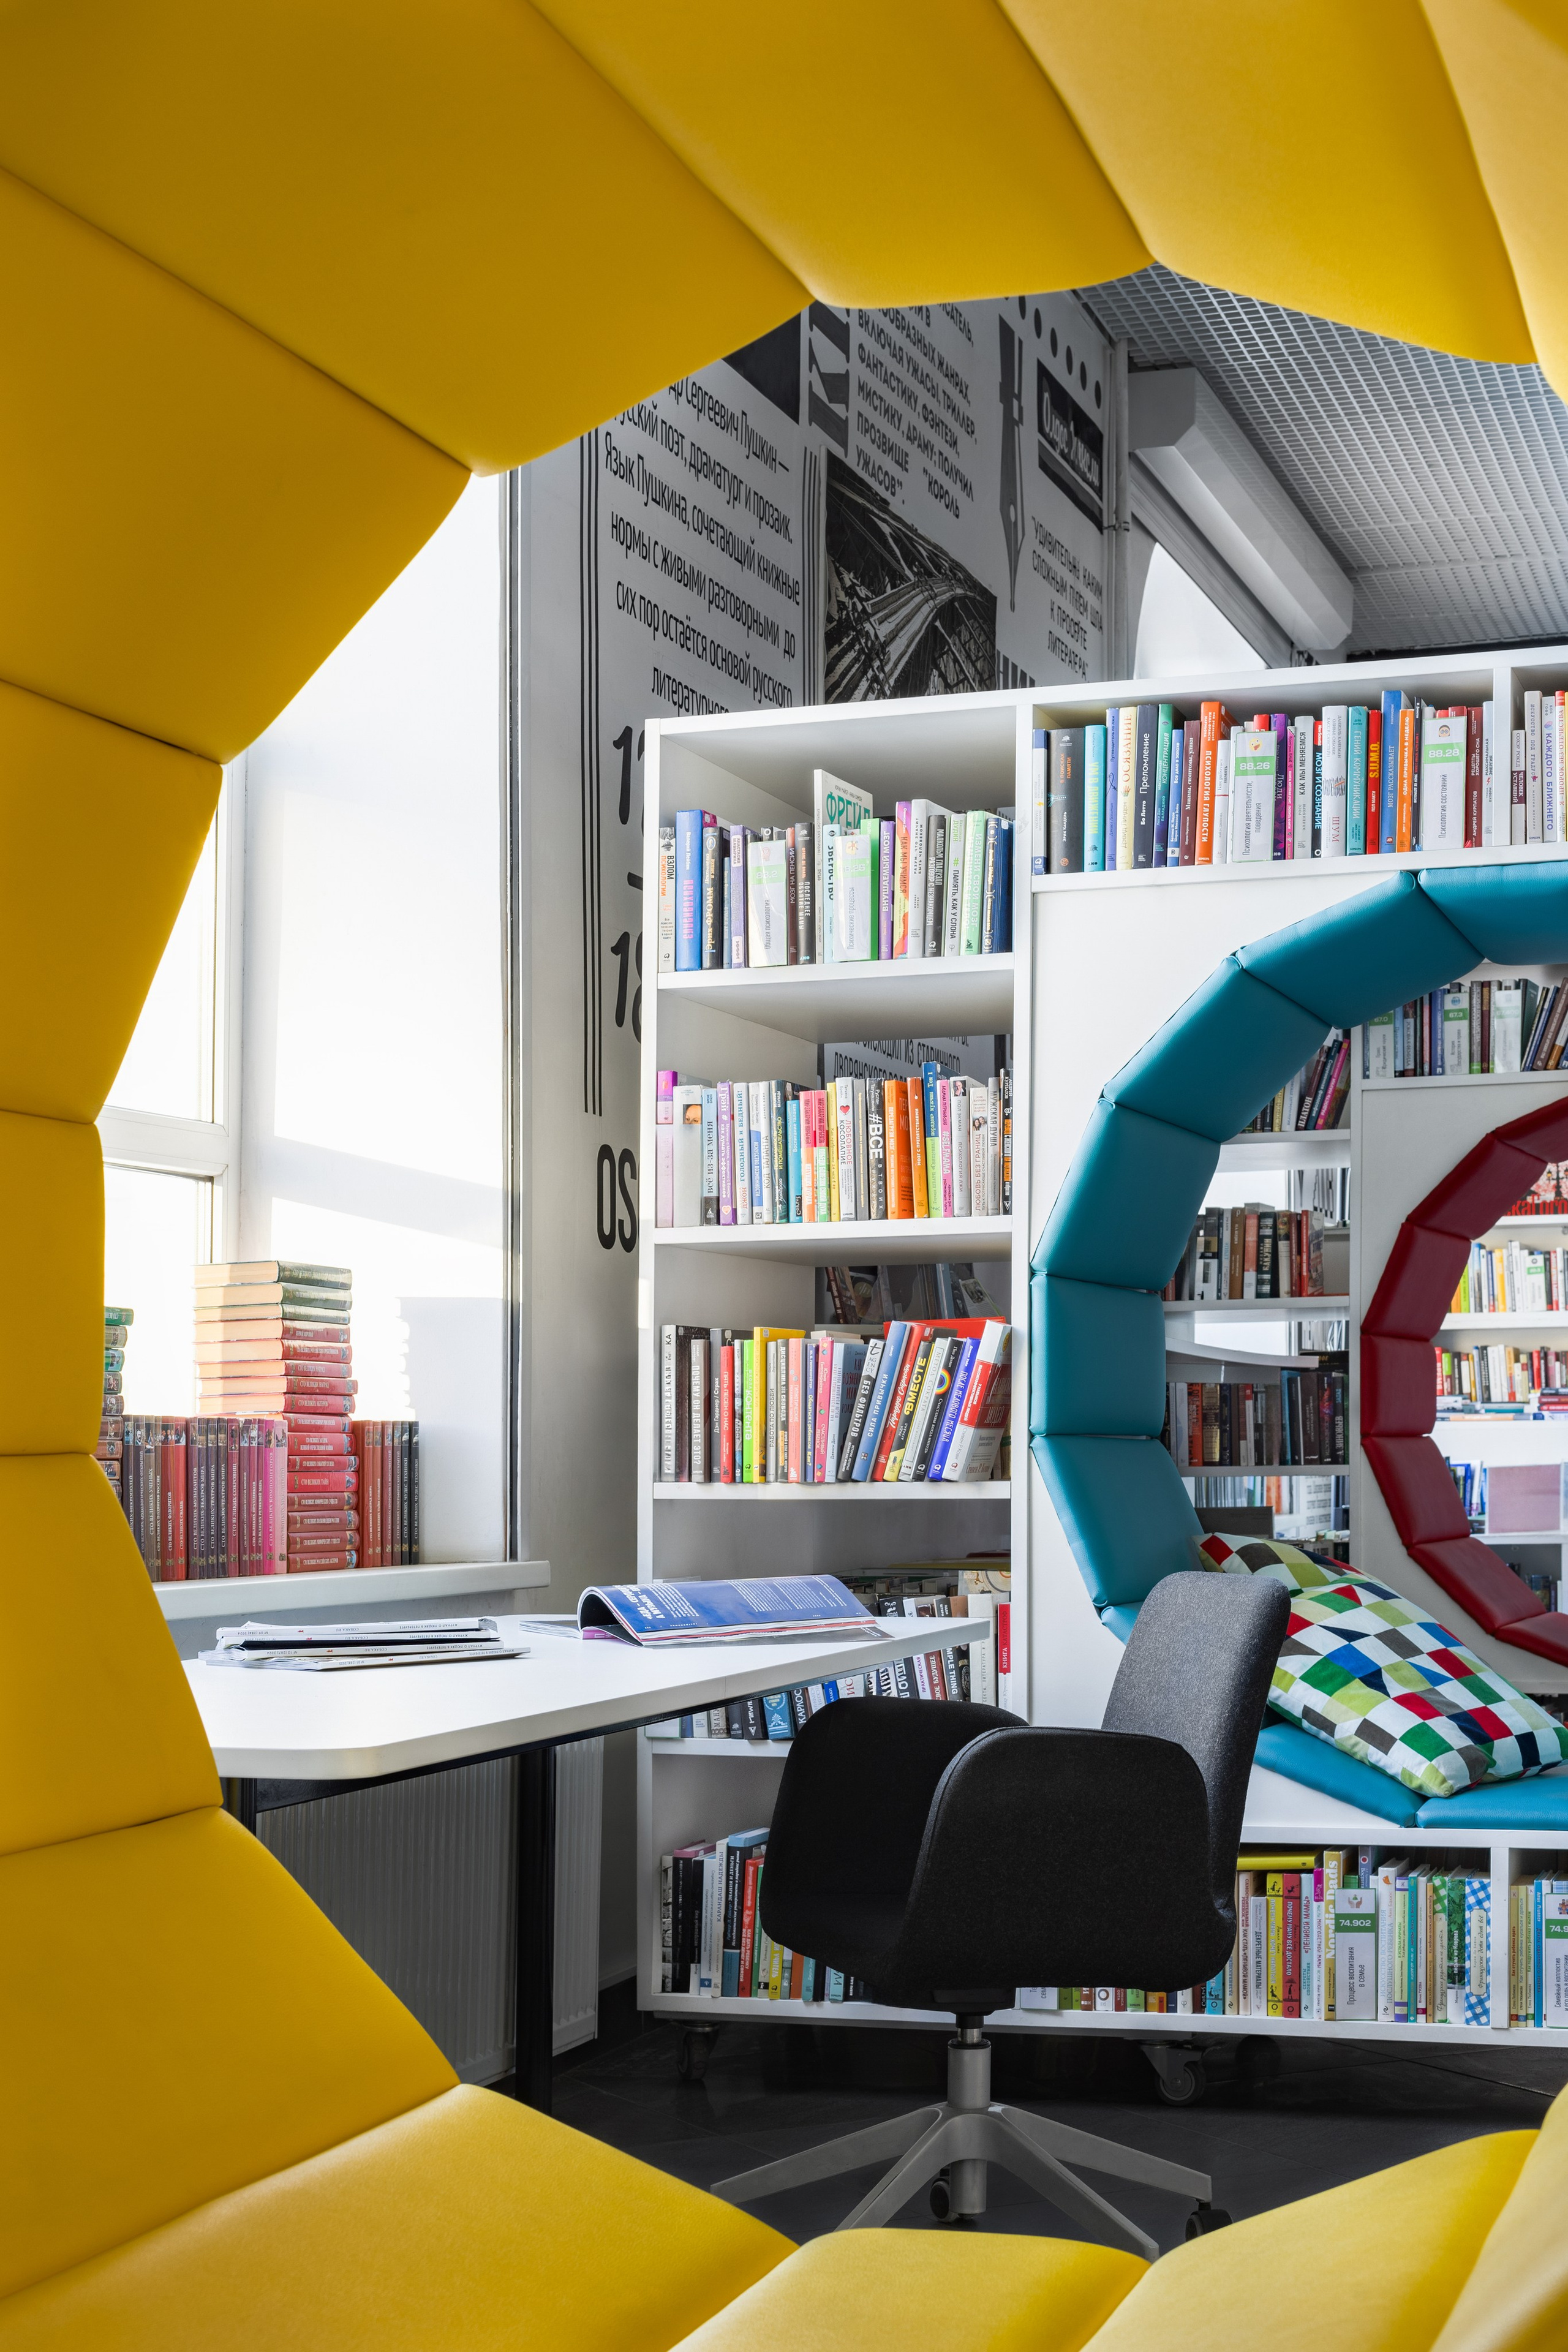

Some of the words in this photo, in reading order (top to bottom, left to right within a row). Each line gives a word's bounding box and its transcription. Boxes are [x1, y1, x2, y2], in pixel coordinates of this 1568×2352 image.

[858, 307, 903, 371] ВКЛЮЧАЯ
[906, 352, 941, 407] УЖАСЫ,
[943, 389, 977, 445] ТРИЛЛЕР,
[937, 351, 971, 408] ЖАНРАХ,
[685, 375, 739, 441] Сергеевич
[741, 409, 777, 473] Пушкин
[858, 410, 910, 473] ПРОЗВИЩЕ
[922, 403, 960, 459] ФЭНТЕЗИ,
[661, 418, 687, 467] поэт,
[689, 441, 744, 510] драматург
[745, 484, 751, 511] и
[753, 489, 793, 545] прозаик.
[907, 421, 937, 469] ДРАМУ;
[938, 449, 974, 502] ПОЛУЧИЛ
[605, 431, 635, 488] Язык
[637, 453, 690, 532] Пушкина,
[692, 503, 756, 574] сочетающий
[756, 555, 800, 606] книжные
[611, 511, 650, 564] нормы
[653, 540, 659, 569] с
[660, 544, 706, 601] живыми
[707, 576, 780, 649] разговорными
[783, 629, 796, 663] до
[616, 581, 637, 619] сих
[639, 594, 660, 641] пор
[662, 614, 707, 662] остаётся
[709, 639, 751, 688] основой
[1121, 714, 1132, 782] ОСЯЗАНИЕ
[1353, 731, 1362, 755] ГЕНИЙ
[1369, 742, 1380, 778] S.U.M.O.
[1428, 748, 1460, 759] 88.28
[1139, 733, 1150, 794] Преломление
[1239, 761, 1270, 771] 88.26
[1299, 769, 1306, 782] МЫ
[1244, 781, 1254, 820] деятельности,
[1352, 758, 1362, 820] КОММУНИКАЦИИ
[1088, 786, 1099, 835] ДВИЖЕНИИ
[1140, 817, 1147, 826] Бо
[936, 829, 944, 859] МАЛКОЛЬМ
[1242, 820, 1251, 856] Психология
[683, 880, 694, 939] ПСИХОАНАЛИЗ
[926, 888, 935, 926] НЕЗНАКОМЦЕМ
[1297, 1096, 1313, 1128] ПЛАТОН
[869, 1114, 883, 1159] #ВСЕ
[1262, 1237, 1272, 1272] БАКУНИН
[862, 1379, 871, 1395] БЕЗ
[904, 1357, 927, 1415] ВМЕСТЕ
[959, 1370, 968, 1390] ПОСЛЕ
[850, 1398, 867, 1438] ФИЛЬТРОВ
[867, 1417, 877, 1438] СИЛА
[875, 1374, 889, 1415] ПРИВЫЧКИ
[951, 1390, 963, 1420] МЕДОВОГО
[941, 1419, 956, 1443] МЕСЯЦА
[916, 1656, 926, 1693] ПРАКТИЧЕСКАЯ
[929, 1655, 940, 1684] БУДУЩЕЕ
[794, 1688, 807, 1725] КАРЛОС
[1325, 1860, 1338, 1901] Dads
[1324, 1903, 1335, 1959] Nordic
[1347, 1977, 1357, 2005] Процесс
